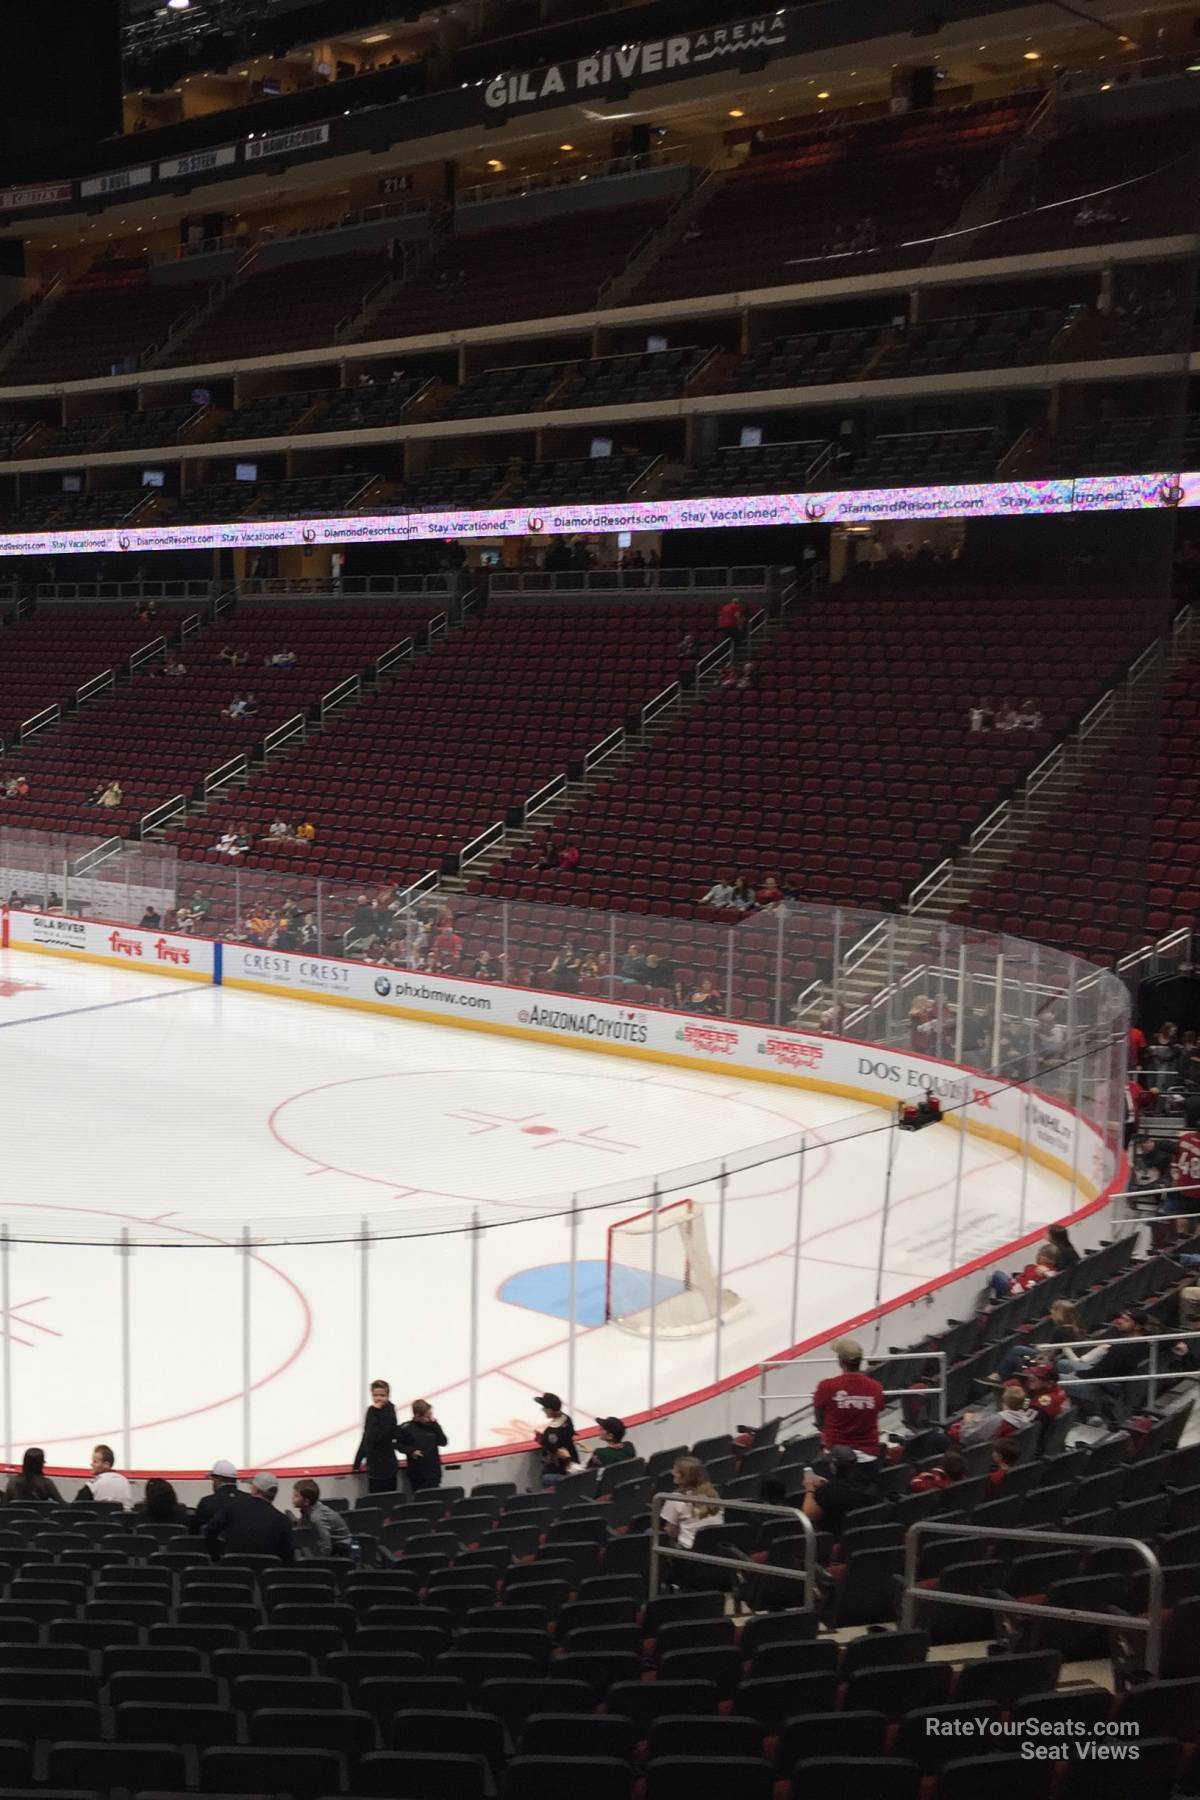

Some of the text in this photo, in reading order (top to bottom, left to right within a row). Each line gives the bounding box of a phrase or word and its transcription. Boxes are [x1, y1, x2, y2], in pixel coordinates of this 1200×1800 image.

[485, 17, 785, 108] GILA RIVER ARENA
[384, 176, 407, 193] 214
[222, 533, 239, 543] Stay
[324, 525, 418, 538] DiamondResorts.com
[429, 522, 448, 533] Stay
[554, 513, 668, 527] DiamondResorts.com
[680, 511, 706, 523] Stay
[999, 496, 1031, 508] Stay
[33, 917, 86, 934] GILA RIVER
[243, 953, 291, 972] CREST
[299, 961, 350, 982] CREST
[395, 982, 492, 1010] phxbmw.com
[857, 1058, 902, 1082] DOS
